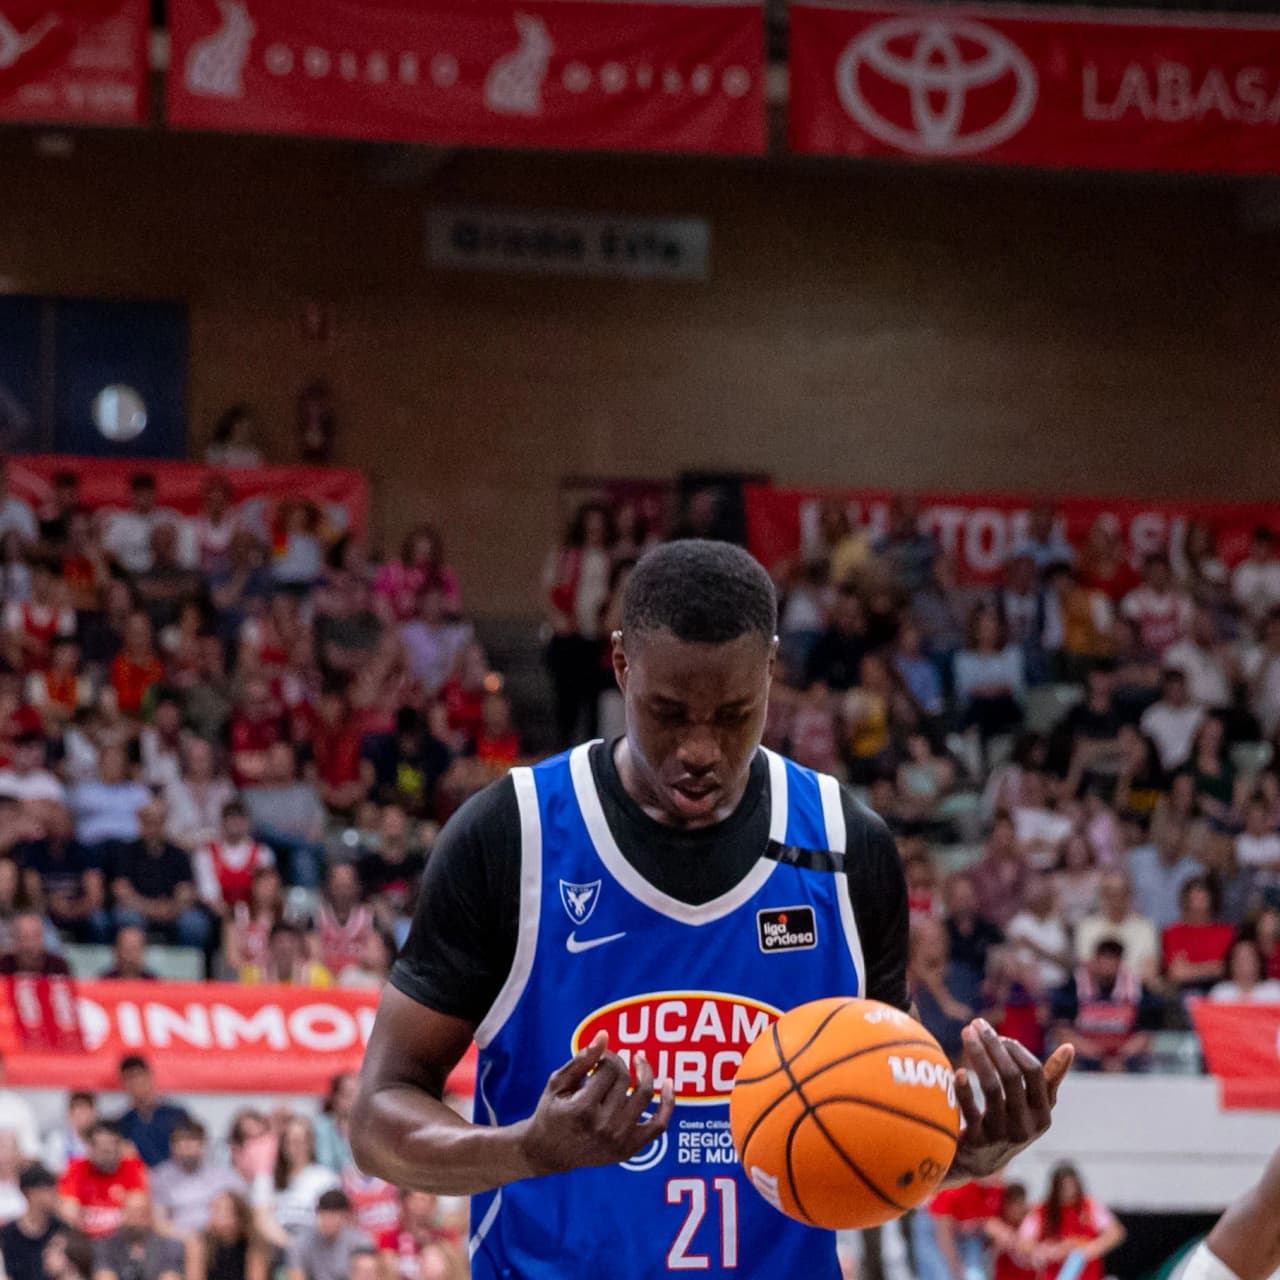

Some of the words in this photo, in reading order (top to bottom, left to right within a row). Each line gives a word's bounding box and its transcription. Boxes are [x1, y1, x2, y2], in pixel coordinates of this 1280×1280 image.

[618, 1000, 770, 1045] UCAM
[678, 1130, 734, 1148] REGIÓ
[666, 1177, 738, 1270] 21
